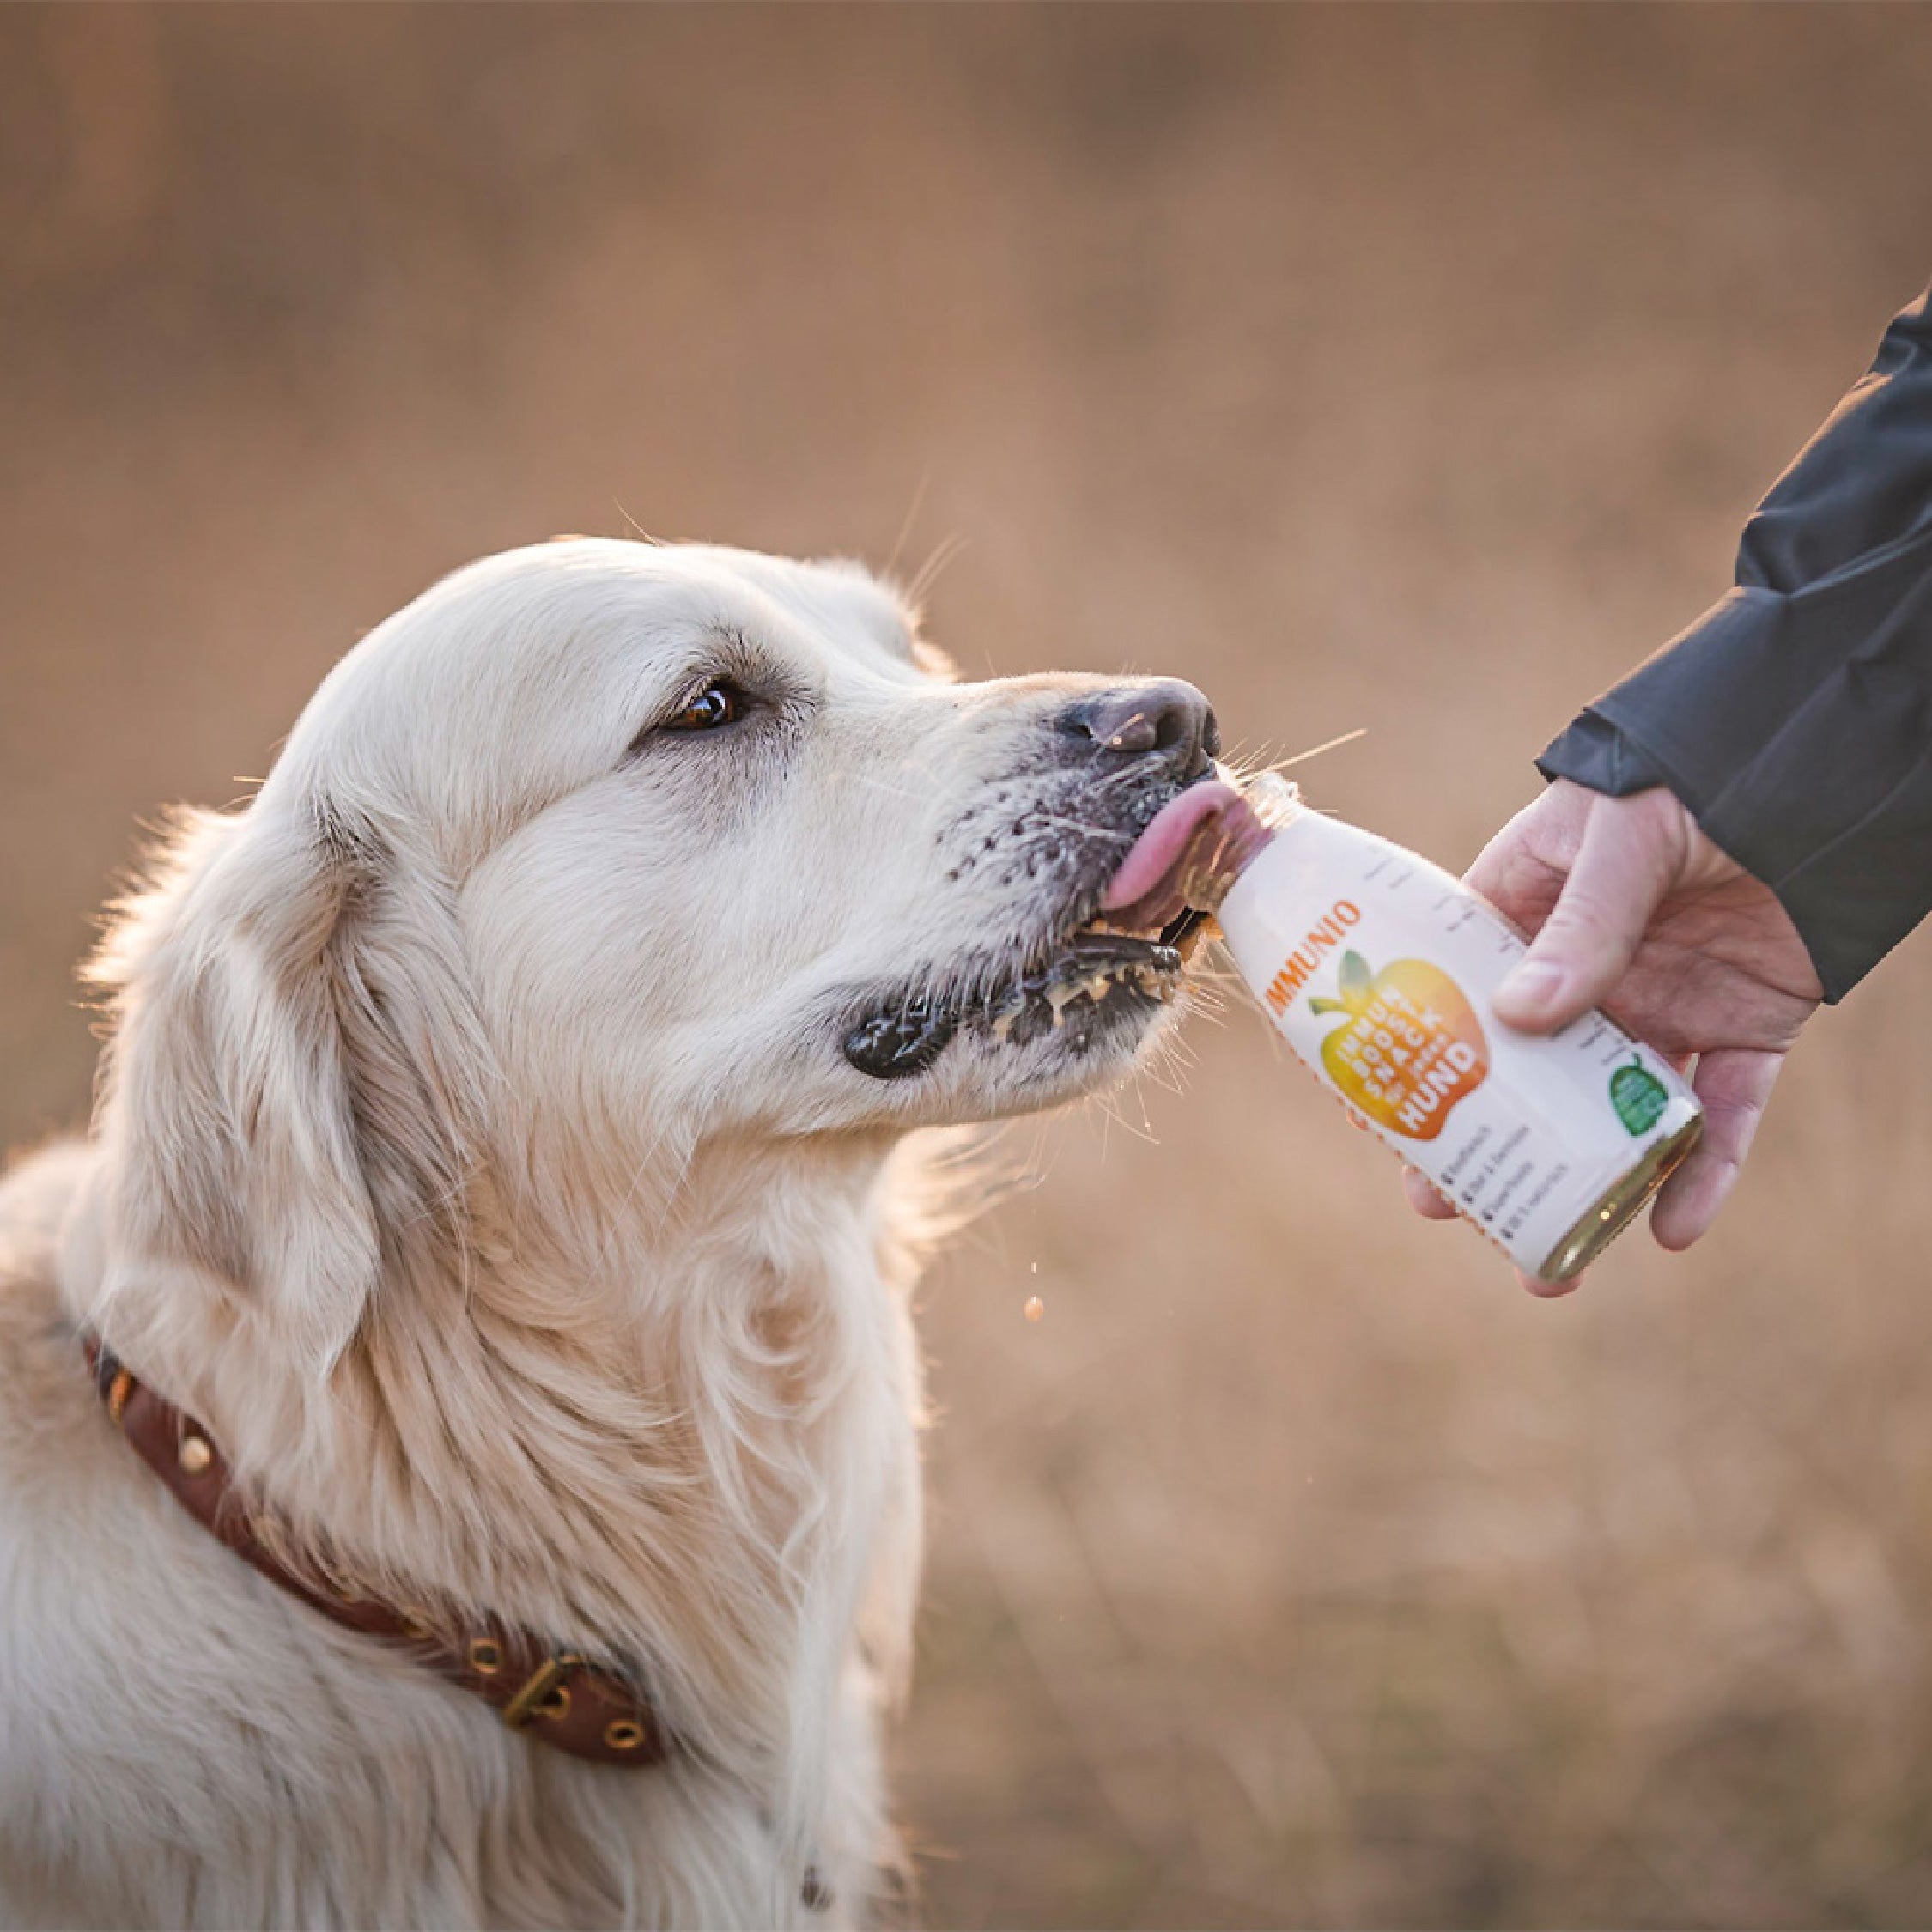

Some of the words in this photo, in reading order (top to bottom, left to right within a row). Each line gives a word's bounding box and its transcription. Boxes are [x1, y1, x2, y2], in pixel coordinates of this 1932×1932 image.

[1266, 900, 1362, 1017] IMMUNIO
[1336, 985, 1402, 1064] IMMUN
[1352, 999, 1419, 1078] BOOST
[1364, 1006, 1443, 1098] SNACK
[1397, 1042, 1476, 1131] HUND
